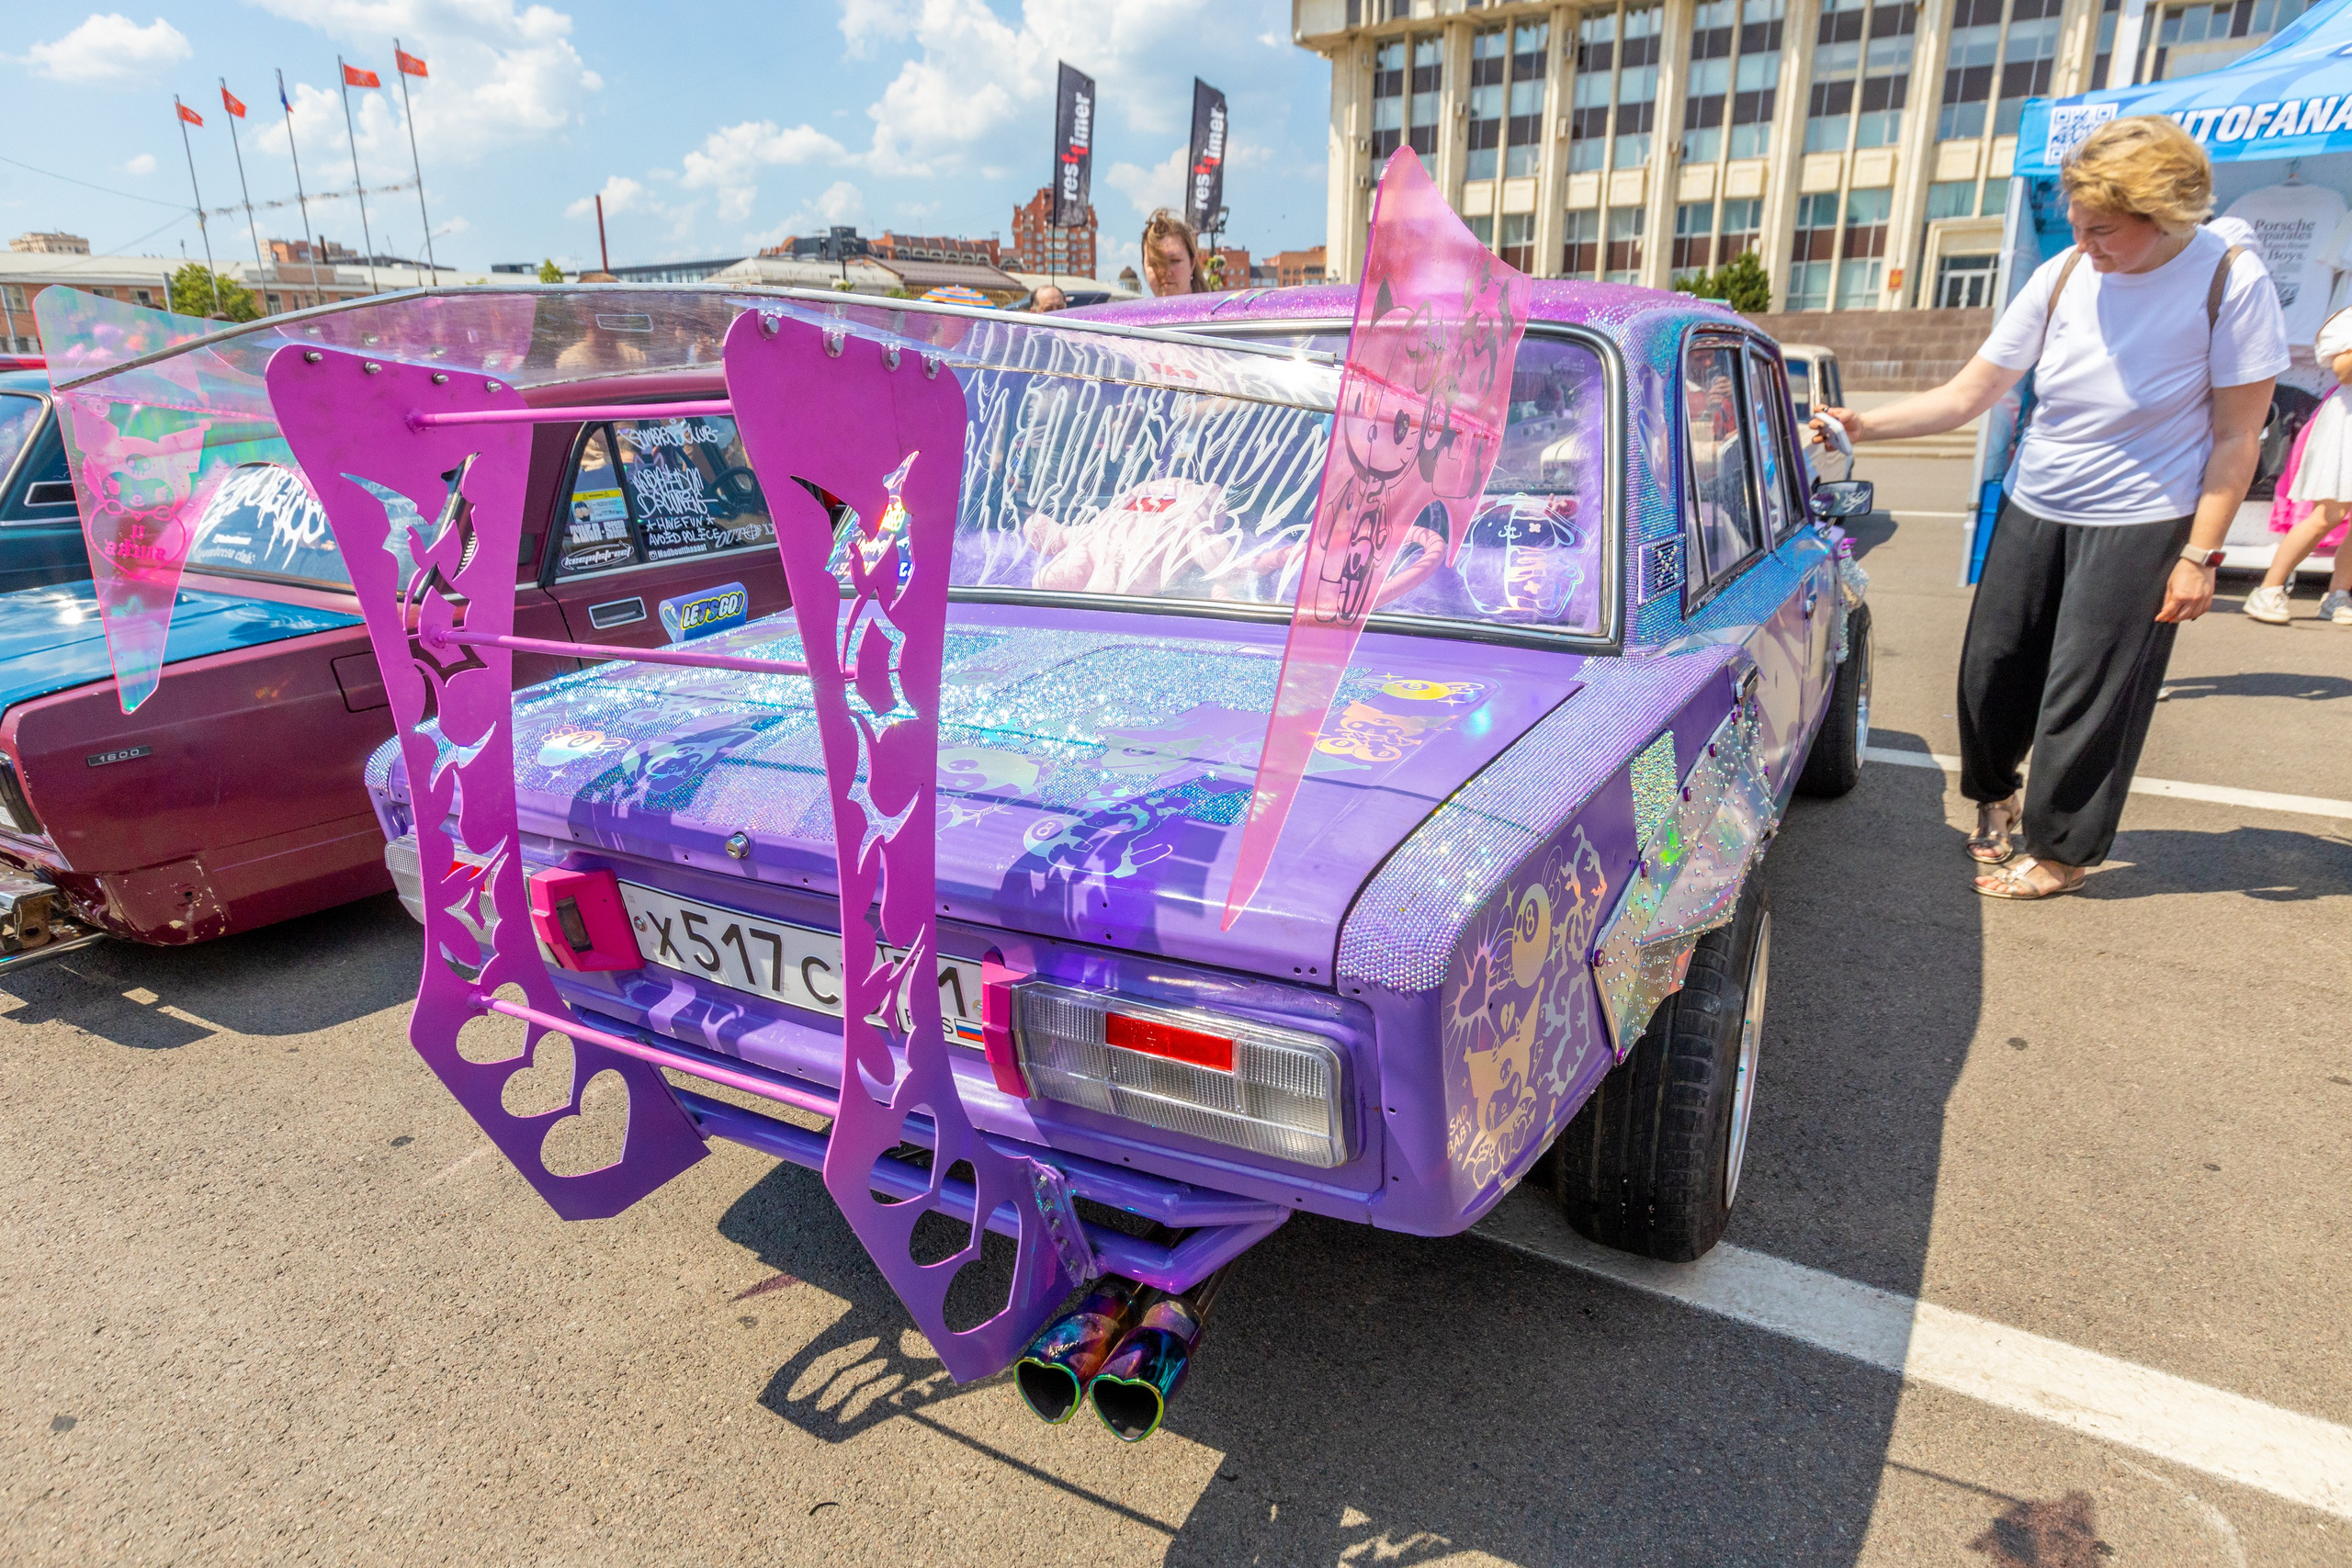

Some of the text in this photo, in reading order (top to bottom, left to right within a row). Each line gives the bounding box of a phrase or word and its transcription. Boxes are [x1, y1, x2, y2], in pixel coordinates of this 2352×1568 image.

[1061, 92, 1091, 201] resttimer
[1194, 107, 1227, 210] resttimer
[2255, 219, 2316, 231] Porsche
[2256, 231, 2313, 242] eparates
[656, 515, 704, 531] HAVE FUN
[649, 526, 719, 547] AVOID POLICE
[718, 592, 744, 618] GO!
[98, 748, 140, 762] 1600
[1525, 903, 1535, 936] 8
[1449, 1104, 1468, 1136] SAD
[1446, 1114, 1474, 1159] BABY
